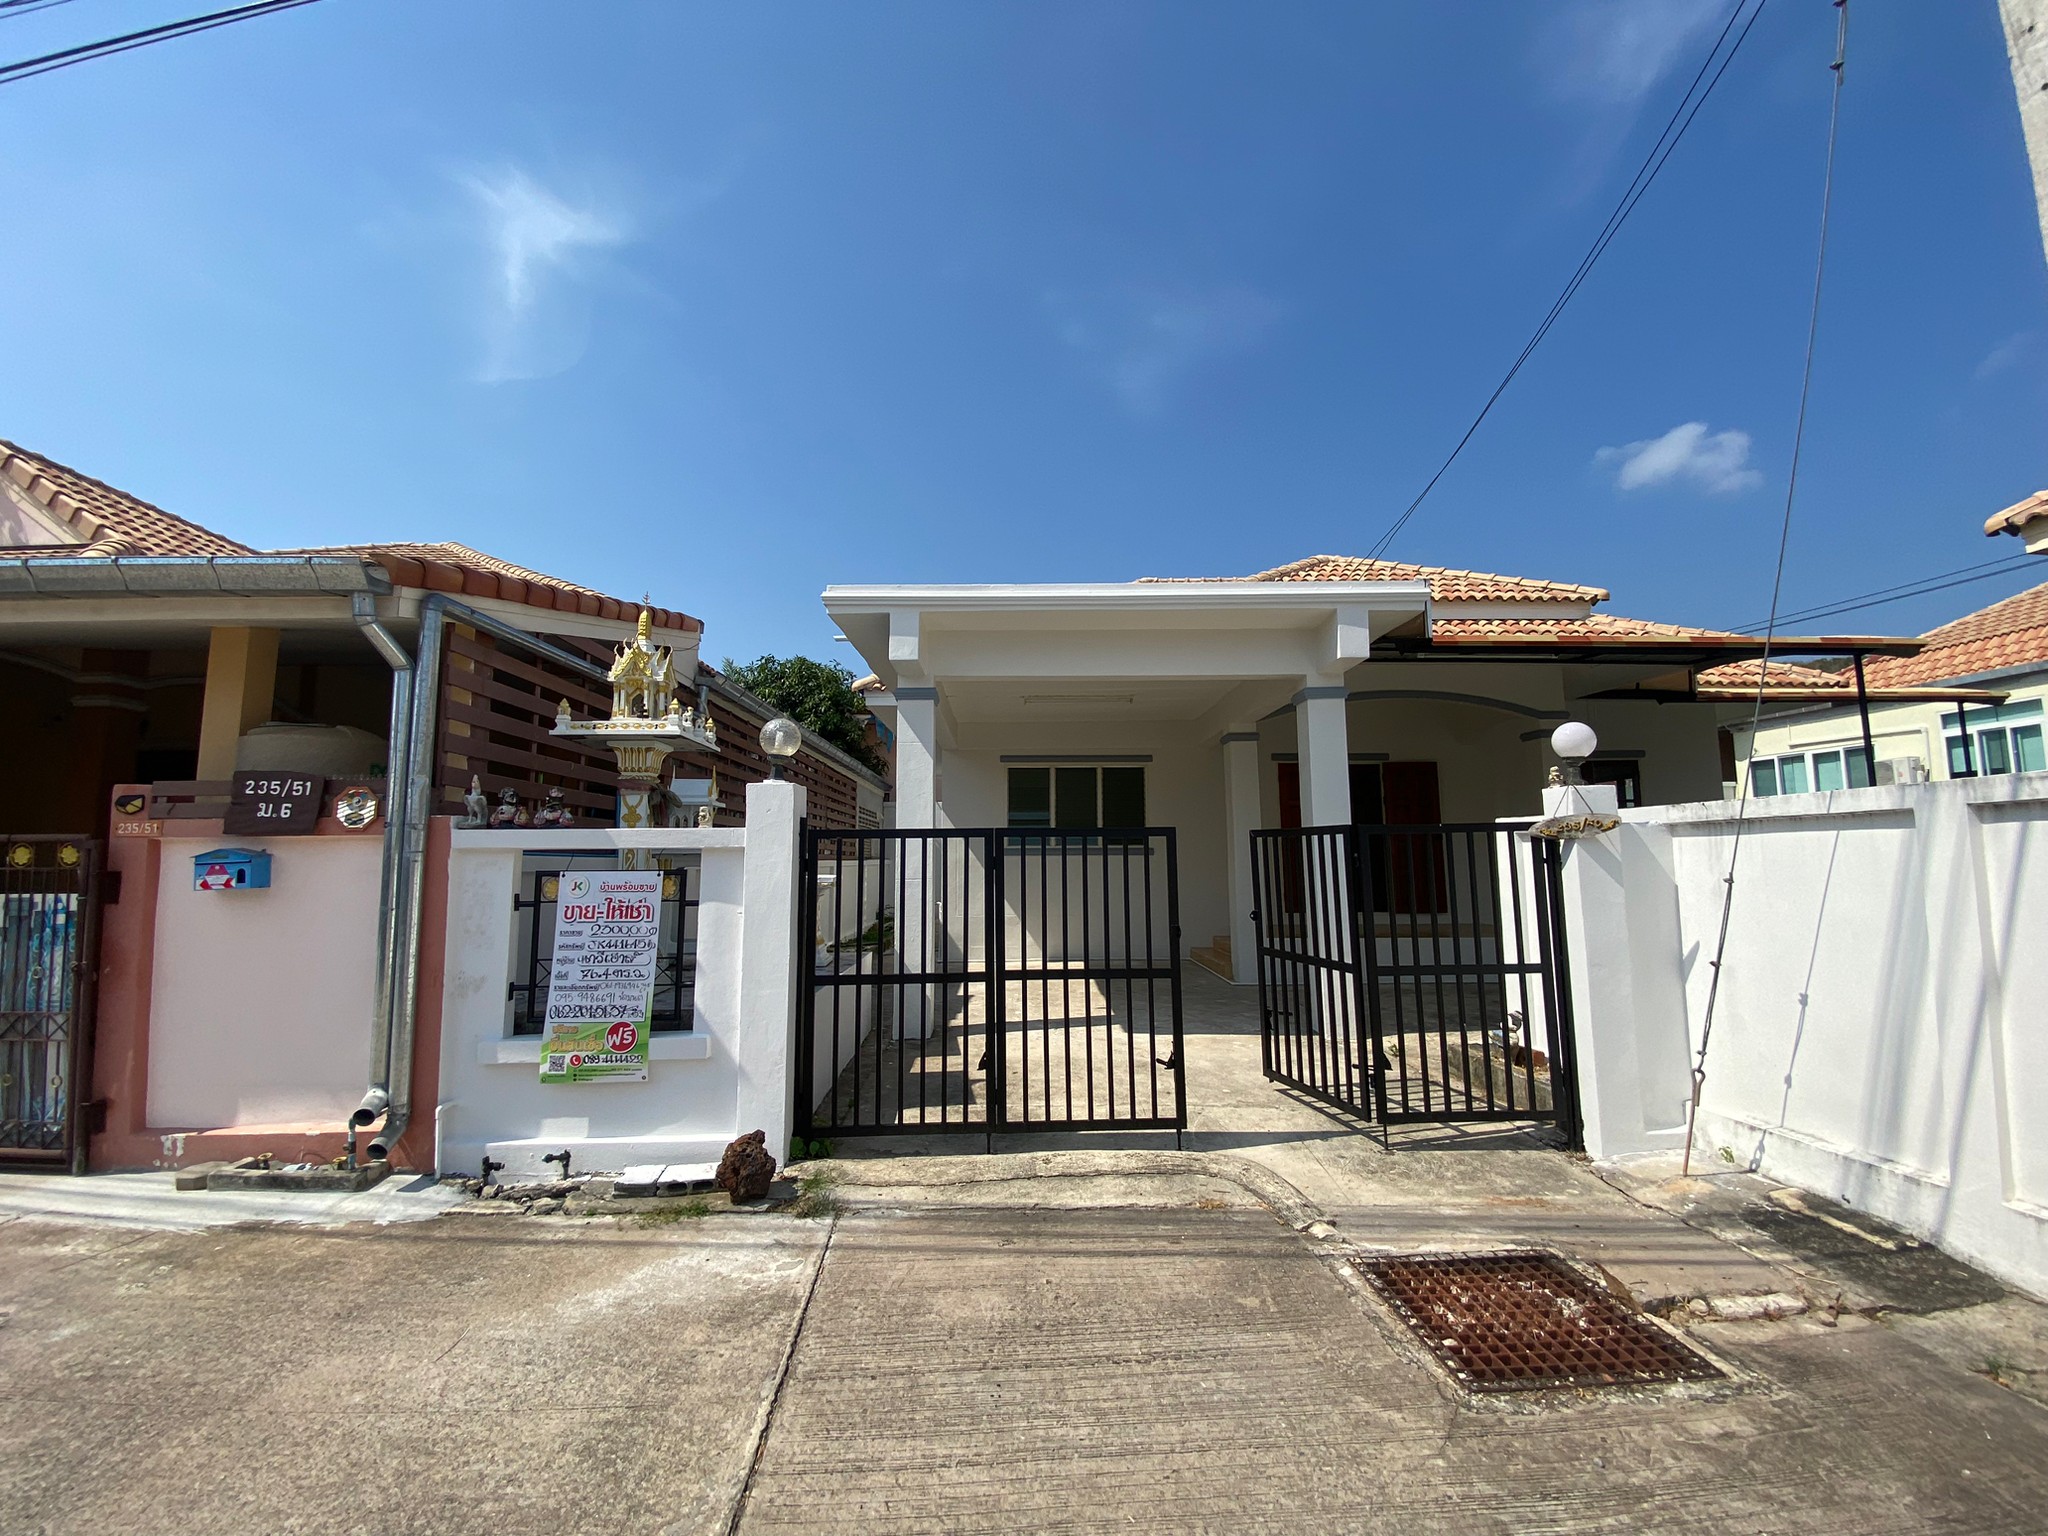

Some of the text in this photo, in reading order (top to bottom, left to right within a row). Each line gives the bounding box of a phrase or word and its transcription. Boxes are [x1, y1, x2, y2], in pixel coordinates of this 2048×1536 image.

[245, 780, 312, 797] 235/51
[256, 802, 292, 819] ม.6
[117, 823, 159, 834] 235/51
[571, 880, 583, 891] JK
[599, 880, 658, 892] บ้านพร้อมขาย
[563, 896, 653, 920] ขาย-ให้เช่า
[607, 1026, 634, 1047] ฟรี
